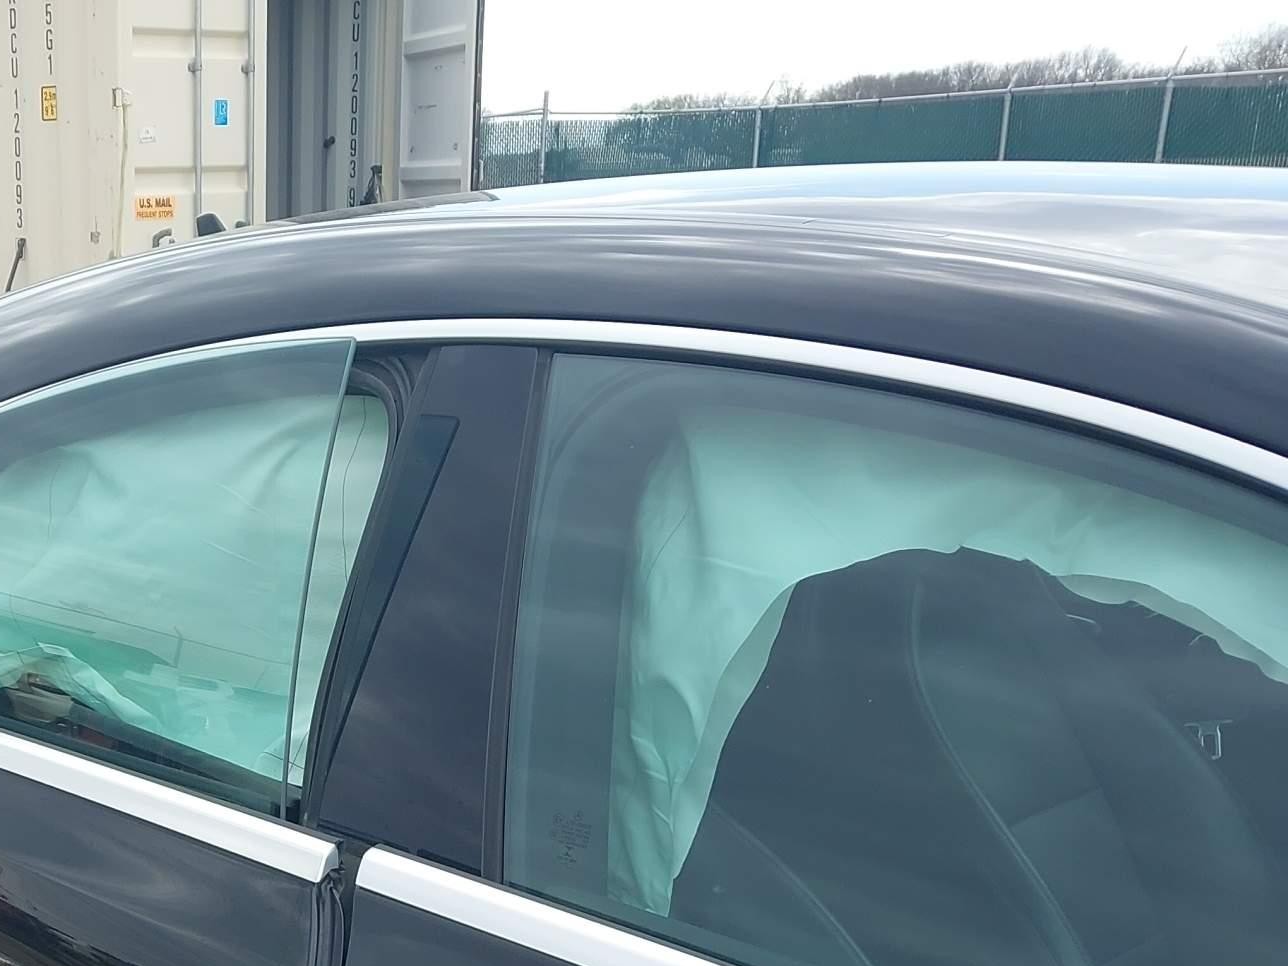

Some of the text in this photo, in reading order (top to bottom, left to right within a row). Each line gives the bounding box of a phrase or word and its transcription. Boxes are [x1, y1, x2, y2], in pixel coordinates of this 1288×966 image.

[8, 0, 23, 228] DCU 120093
[349, 51, 359, 178] 120093
[139, 196, 172, 208] U.S. MAIL
